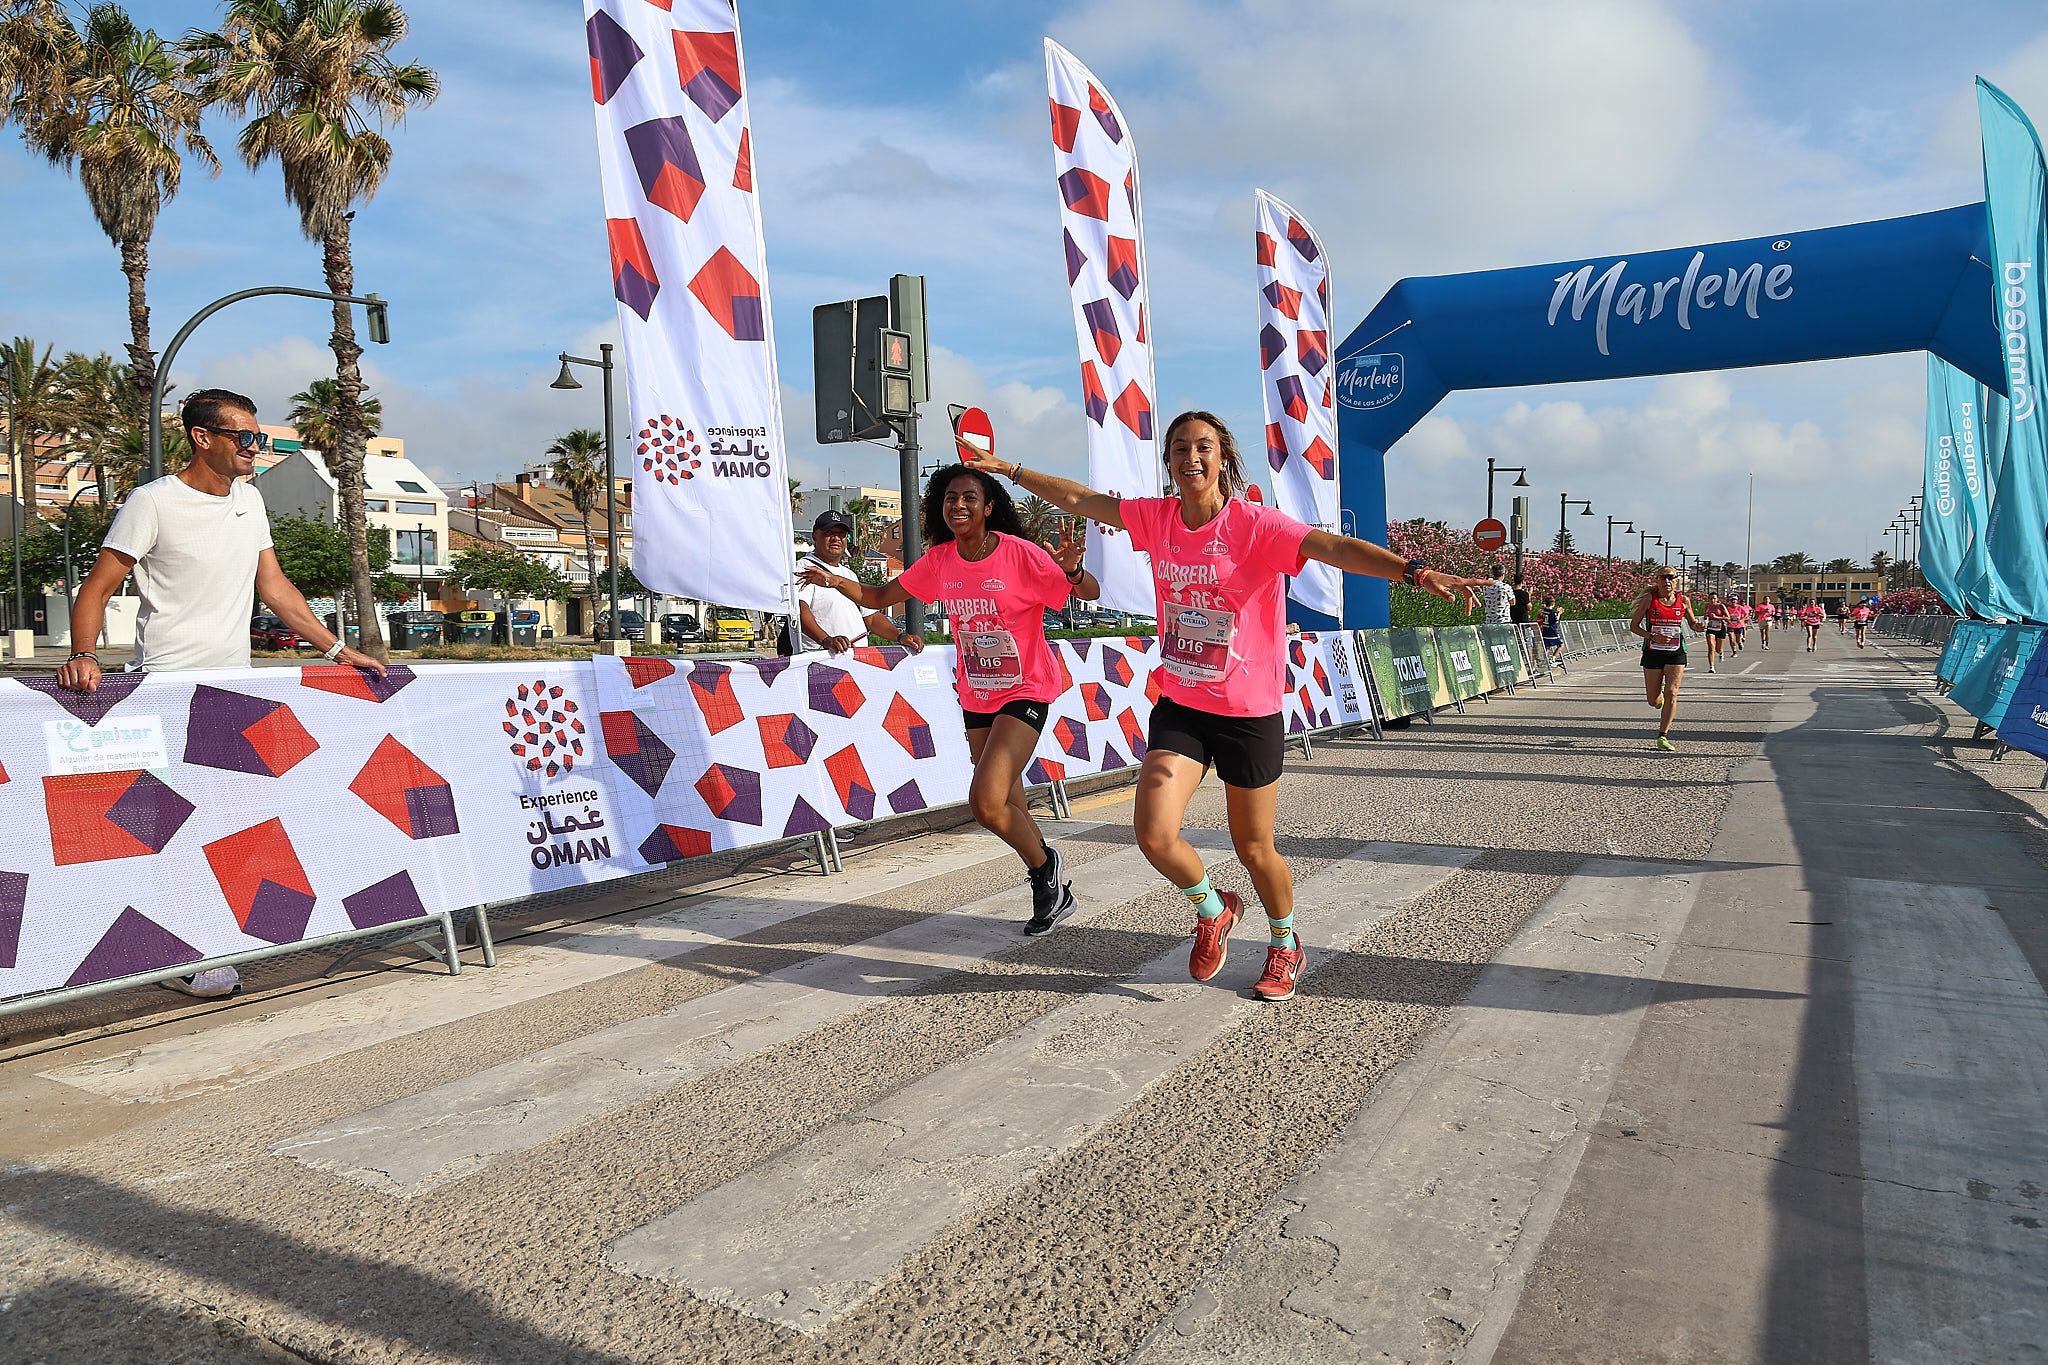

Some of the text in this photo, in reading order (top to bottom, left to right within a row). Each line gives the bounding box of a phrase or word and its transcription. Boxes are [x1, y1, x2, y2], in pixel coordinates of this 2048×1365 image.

[1547, 250, 1794, 356] Marlene
[1338, 366, 1398, 395] Marlene
[1157, 559, 1219, 585] CARRERA
[944, 598, 999, 616] CARRERA
[1177, 638, 1204, 653] 016
[980, 657, 1002, 668] 016
[94, 753, 105, 761] de
[106, 751, 141, 761] material
[142, 751, 159, 760] para
[72, 761, 151, 773] Eventos Deportivos
[520, 789, 598, 811] Experience
[531, 836, 612, 870] OMAN
